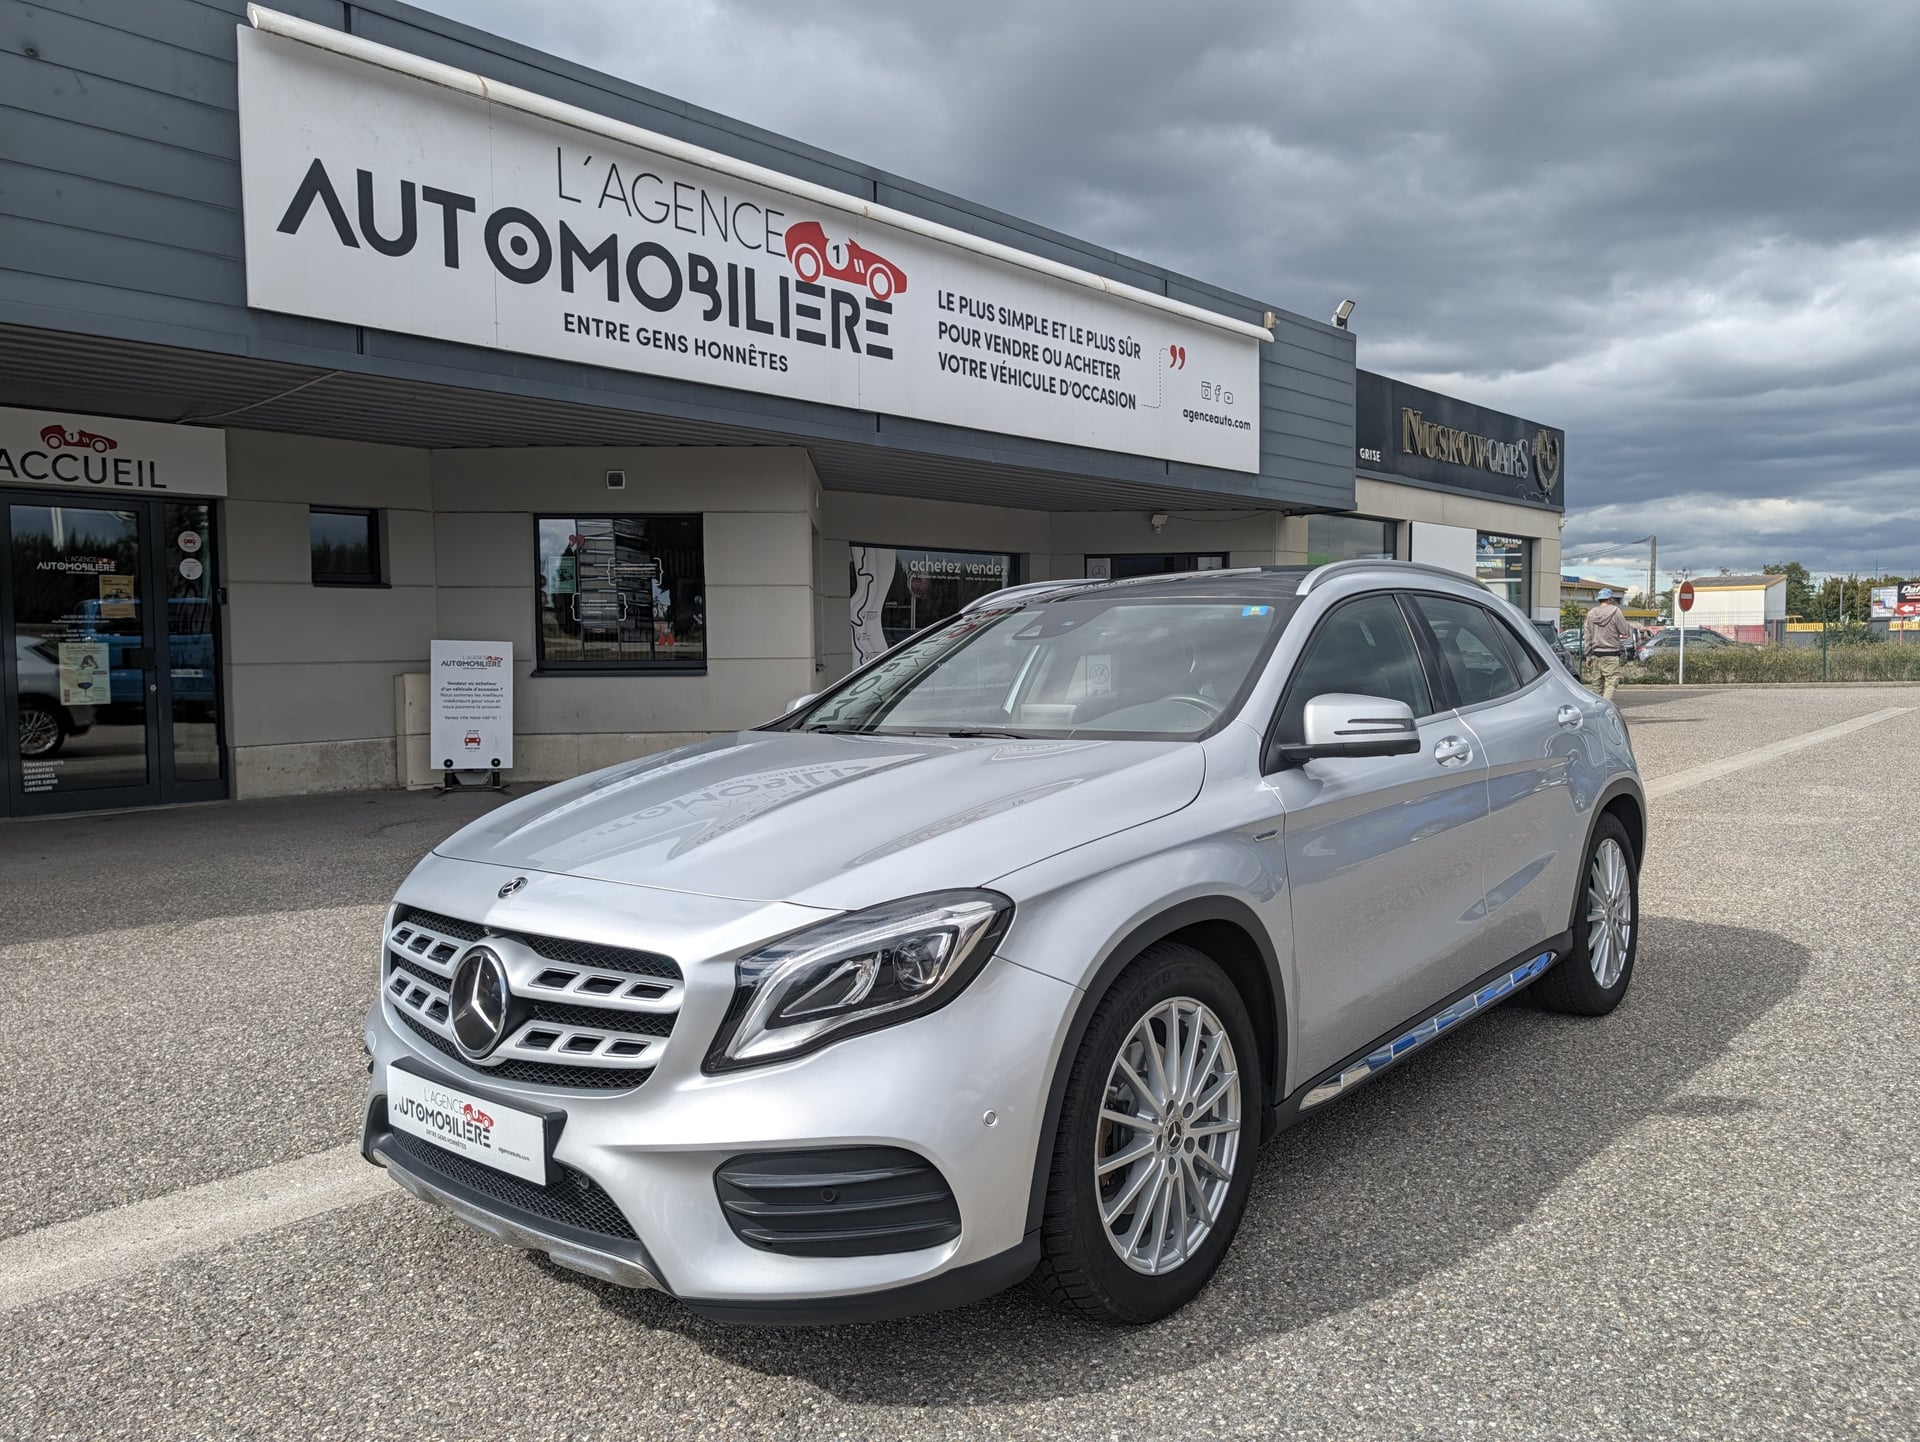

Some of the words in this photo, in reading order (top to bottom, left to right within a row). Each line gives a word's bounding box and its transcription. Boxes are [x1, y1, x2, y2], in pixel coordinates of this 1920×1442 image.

[557, 146, 785, 258] L'AGENCE
[564, 313, 629, 343] ENTRE
[636, 327, 688, 355] GENS
[695, 339, 789, 374] HONNÊTES
[938, 289, 955, 312] LE
[959, 296, 995, 322] PLUS
[999, 302, 1048, 336] SIMPLE
[1052, 319, 1066, 340] ET
[1069, 323, 1083, 344] LE
[1086, 328, 1115, 353] PLUS
[1118, 335, 1141, 360] SÛR
[938, 321, 981, 350] POUR
[984, 331, 1039, 362] VENDRE
[1042, 346, 1062, 367] OU
[1064, 353, 1121, 382] ACHETER
[938, 351, 987, 381] VOTRE
[990, 359, 1056, 395] VÉHICULE
[1060, 379, 1136, 411] D'OCCASION
[1182, 407, 1251, 431] agenceauto.com
[0, 448, 167, 488] ACCUEIL
[1359, 447, 1381, 462] GRISE
[910, 554, 960, 573] achetez
[966, 558, 1008, 576] vendez
[424, 1088, 465, 1116] L'AGENCE
